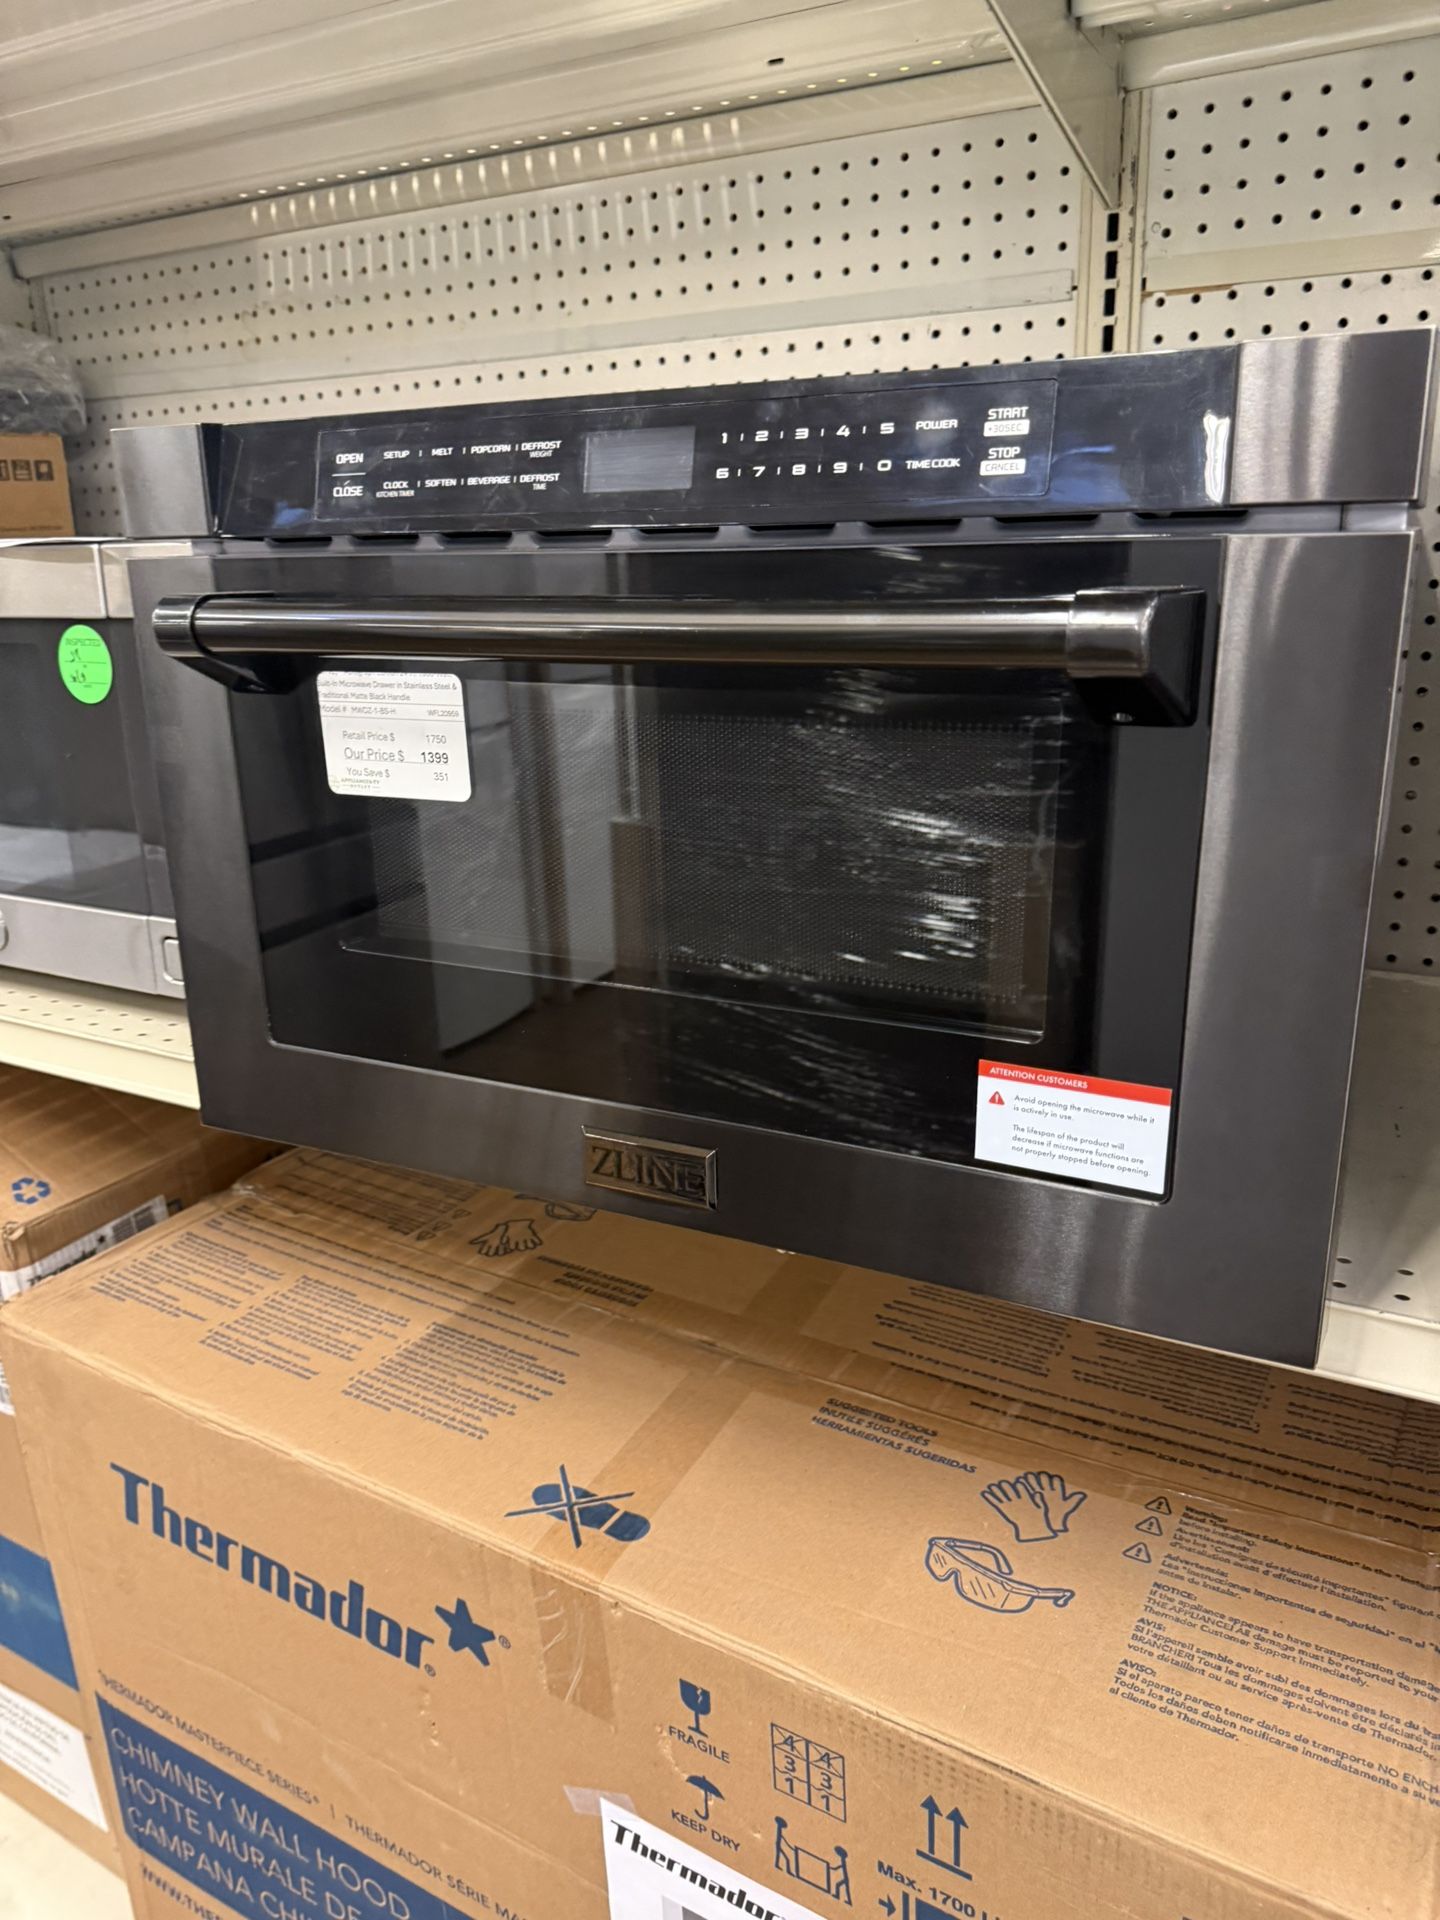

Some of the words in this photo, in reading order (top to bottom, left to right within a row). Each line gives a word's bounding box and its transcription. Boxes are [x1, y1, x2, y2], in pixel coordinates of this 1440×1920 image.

[915, 418, 958, 431] POWER
[988, 406, 1029, 420] START
[721, 431, 728, 444] 1
[755, 430, 769, 442] 2
[794, 427, 809, 440] 3
[836, 424, 851, 437] 4
[879, 422, 895, 434] 5
[336, 452, 363, 465] OPEN
[383, 449, 410, 461] SETUP
[431, 447, 454, 458] MELT
[470, 443, 511, 455] POPCORN
[521, 440, 562, 452] DEFROST
[529, 449, 553, 458] WEIGHT
[905, 459, 931, 470] TIME
[931, 457, 961, 468] COOK
[988, 446, 1021, 459] STOP
[716, 467, 729, 479] 6
[752, 465, 766, 478] 7
[791, 463, 806, 476] 8
[833, 461, 848, 474] 9
[985, 461, 1021, 472] CANCEL
[332, 485, 363, 498] CLOSE
[383, 480, 409, 489] CLOCK
[425, 477, 457, 488] SOFTEN
[467, 474, 511, 487] BEVERAGE
[519, 472, 560, 484] DEFROST
[532, 482, 547, 491] TIME
[342, 730, 366, 740] Retail
[367, 732, 389, 742] Price
[425, 735, 447, 744] 1750
[344, 747, 365, 760] Our
[367, 749, 396, 762] Price
[397, 750, 406, 763] $
[420, 752, 449, 764] 1399
[346, 767, 363, 777] You
[363, 768, 384, 778] Save
[433, 772, 449, 782] 351
[989, 1066, 1036, 1081] ATTENTION
[1036, 1073, 1089, 1090] CUSTOMERS
[1014, 1095, 1036, 1104] Avoid
[1037, 1099, 1068, 1111] opening
[1069, 1103, 1081, 1111] the
[1083, 1107, 1125, 1119] microwave
[1127, 1113, 1148, 1123] while
[1020, 1107, 1049, 1118] actively
[1013, 1123, 1025, 1132] The
[1026, 1126, 1056, 1138] lifespan
[1066, 1134, 1078, 1142] the
[1079, 1137, 1110, 1148] product
[1012, 1134, 1045, 1146] decrease
[1053, 1142, 1094, 1155] microwave
[1095, 1148, 1129, 1162] functions
[1130, 1157, 1144, 1165] are
[592, 1145, 706, 1196] ZLINE
[1024, 1148, 1056, 1160] properly
[1058, 1153, 1088, 1165] stopped
[1089, 1158, 1115, 1170] before
[1116, 1165, 1152, 1178] opening.
[898, 1419, 940, 1438] TOOLS
[812, 1414, 903, 1450] HERRAMIENTAS
[904, 1445, 978, 1474] SUGERIDAS
[109, 1462, 435, 1669] Thermador
[1136, 1617, 1166, 1632] AVIS:
[1143, 1604, 1199, 1629] Thermador
[1200, 1624, 1251, 1647] Customer
[1253, 1641, 1297, 1663] Support
[1178, 1600, 1226, 1619] appliance
[1228, 1616, 1269, 1634] appears
[1272, 1630, 1284, 1639] to
[1286, 1633, 1312, 1648] have
[1314, 1644, 1394, 1675] transportation
[1120, 1658, 1157, 1678] AVISO:
[1196, 1655, 1222, 1671] Tous
[1253, 1633, 1296, 1652] damage
[1298, 1648, 1325, 1663] must
[1327, 1657, 1343, 1668] be
[1344, 1664, 1396, 1686] reported
[1235, 1661, 1264, 1675] avoir
[1265, 1671, 1289, 1684] subi
[1290, 1680, 1311, 1692] des
[1313, 1688, 1377, 1715] dommages
[1120, 1690, 1157, 1710] cliente
[1176, 1710, 1240, 1742] Thermador.
[1141, 1678, 1183, 1697] aparato
[1183, 1693, 1222, 1712] parece
[1223, 1706, 1255, 1723] tener
[1257, 1719, 1291, 1737] daños
[1293, 1733, 1310, 1745] de
[1311, 1740, 1375, 1769] transporte
[1377, 1762, 1400, 1778] NO
[1240, 1684, 1279, 1702] service
[1281, 1698, 1349, 1727] après-vente
[1351, 1723, 1367, 1734] de
[1370, 1728, 1438, 1761] Thermador.
[668, 1725, 731, 1764] FRAGILE
[1113, 1675, 1146, 1695] Todos
[1147, 1688, 1164, 1701] los
[1166, 1697, 1199, 1715] daños
[1201, 1710, 1237, 1729] deben
[1239, 1724, 1299, 1752] notificarse
[1302, 1746, 1399, 1790] inmediatamente
[785, 1755, 796, 1773] 3
[821, 1772, 833, 1790] 3
[785, 1776, 795, 1795] 1
[821, 1794, 831, 1813] 1
[110, 1727, 225, 1812] CHIMNEY
[230, 1797, 310, 1864] WALL
[315, 1847, 411, 1920] HOOD
[118, 1765, 203, 1836] HOTTE
[207, 1820, 318, 1906] MURALE
[671, 1809, 707, 1834] KEEP
[710, 1830, 741, 1852] DRY
[127, 1806, 256, 1903] CAMPANA
[345, 1814, 442, 1880] THERMADOR
[446, 1874, 491, 1910] SÉRIE
[877, 1859, 923, 1893] Max.
[928, 1886, 976, 1918] 1700
